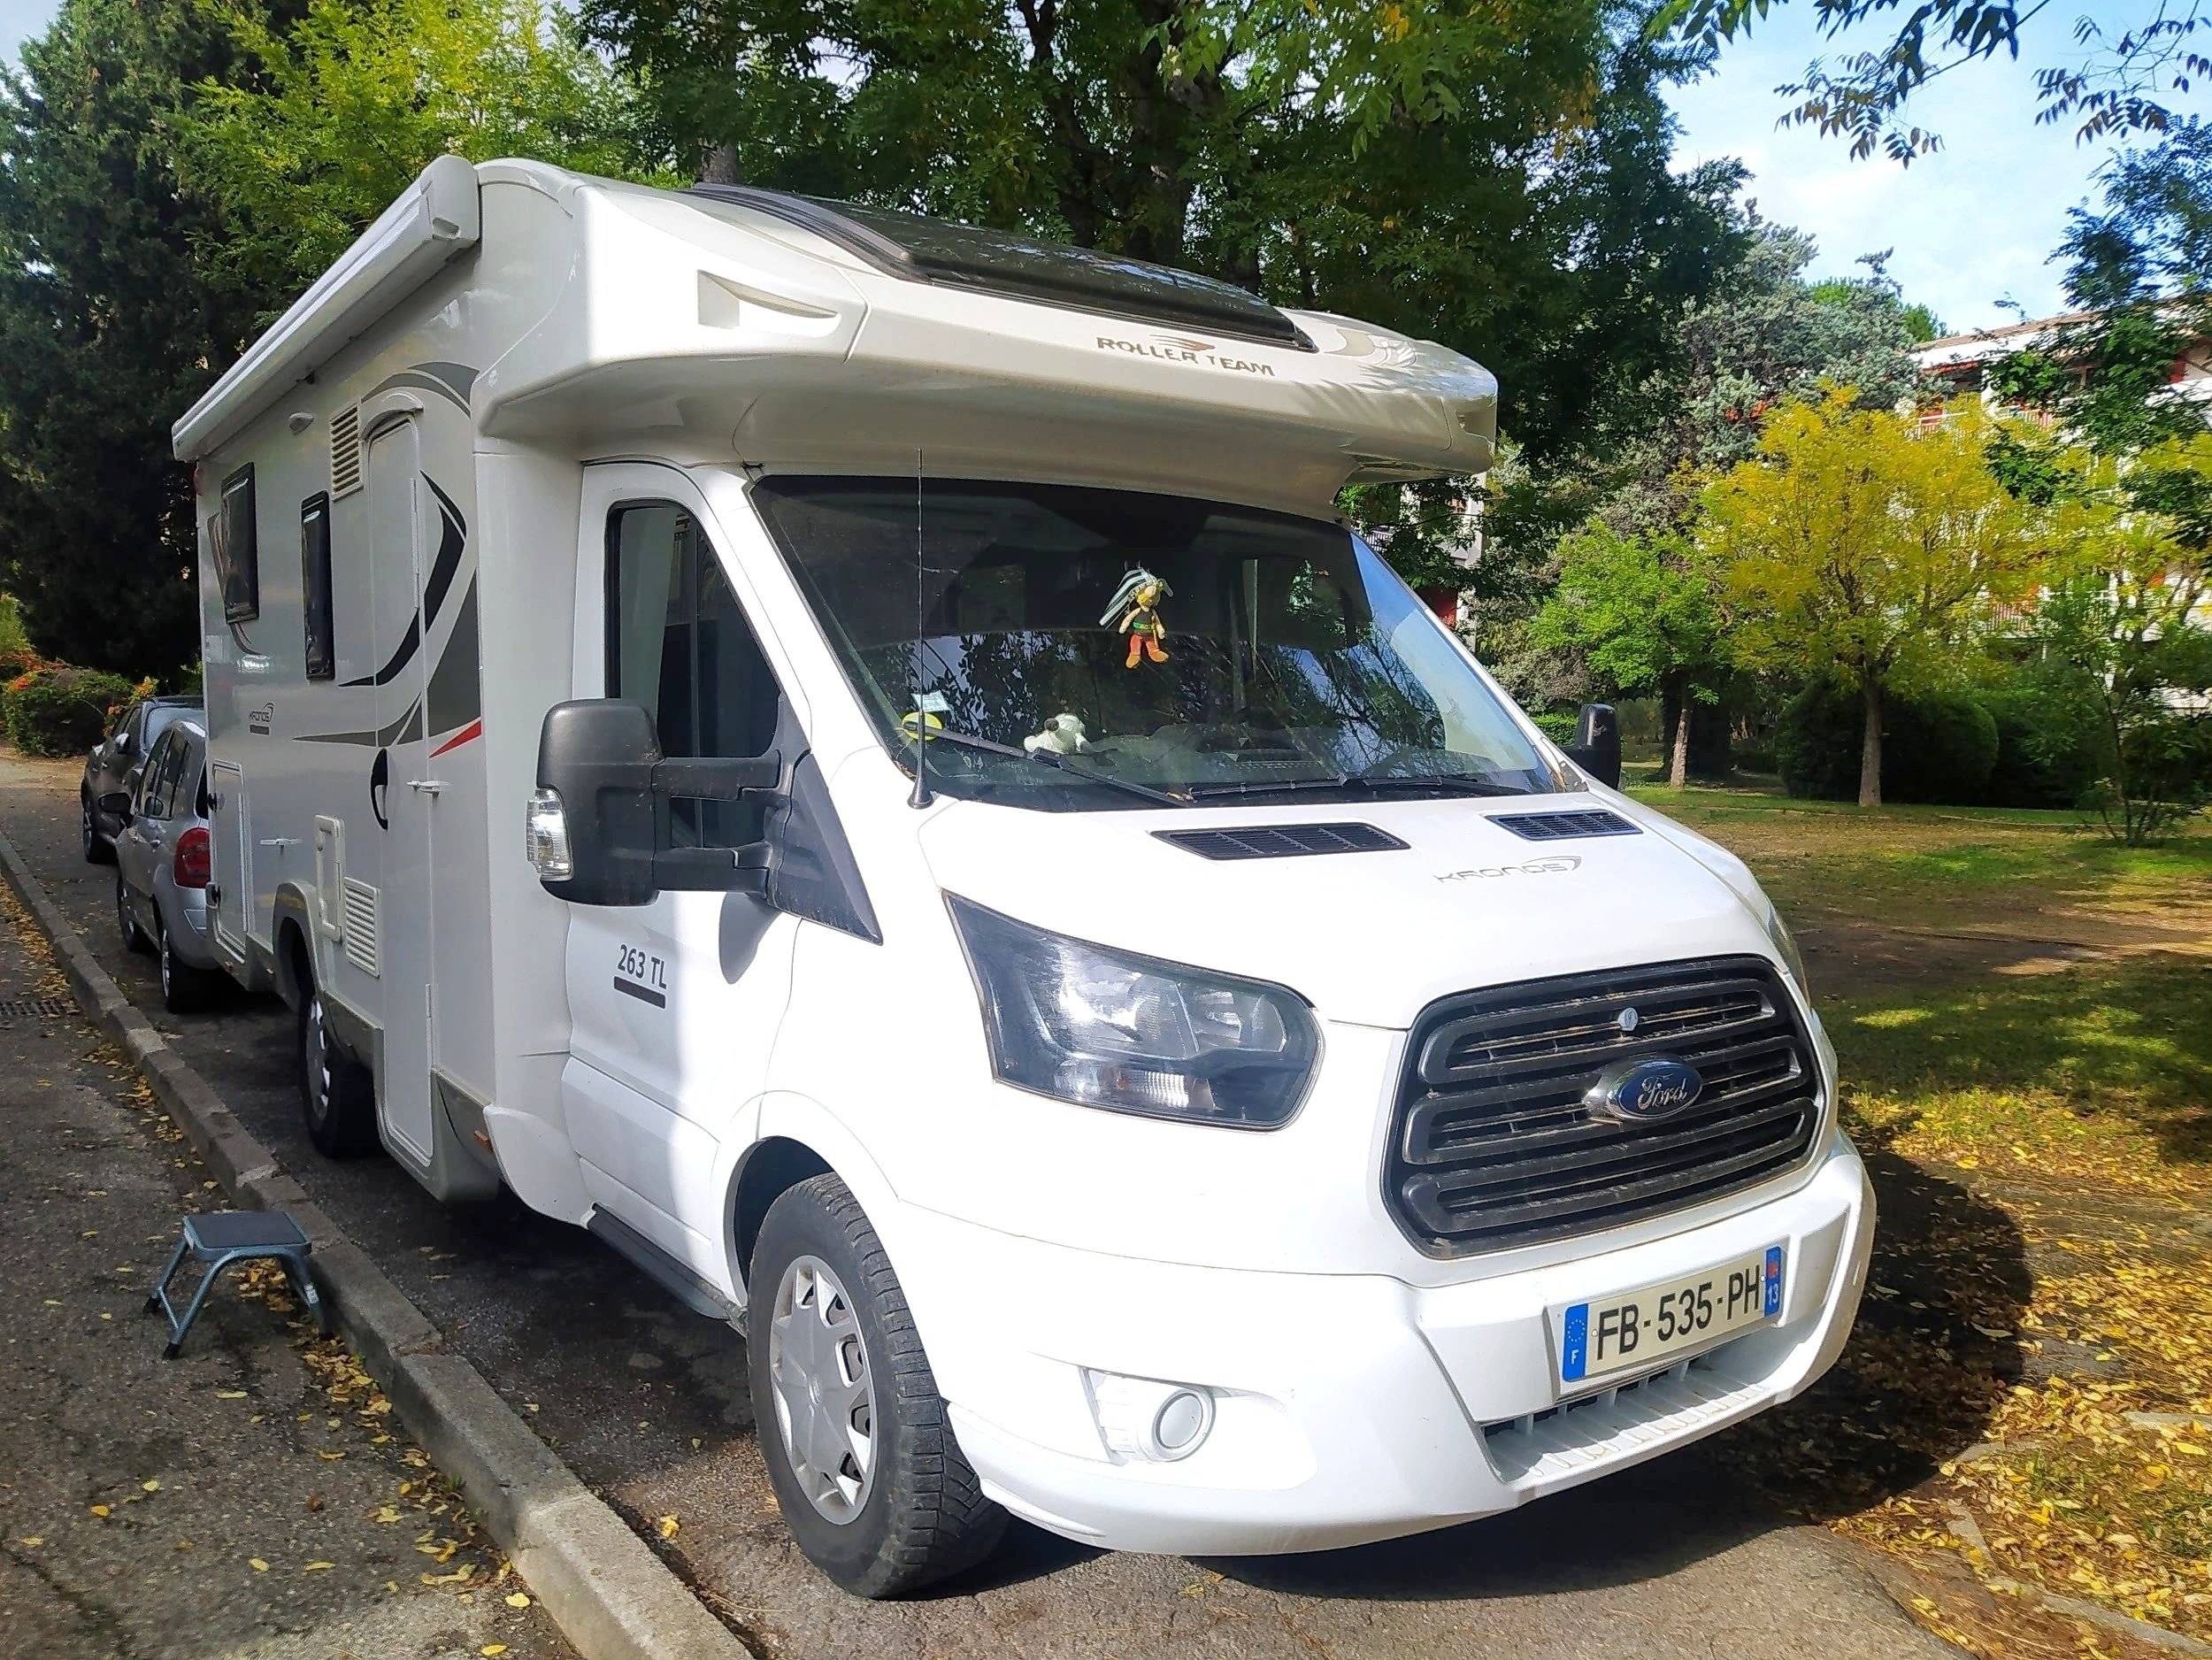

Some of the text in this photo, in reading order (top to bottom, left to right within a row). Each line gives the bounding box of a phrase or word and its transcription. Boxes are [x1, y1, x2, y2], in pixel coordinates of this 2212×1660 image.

[1095, 336, 1276, 377] ROLLER TEAM
[617, 943, 667, 990] 263 TL
[1637, 1072, 1688, 1111] Ford
[1596, 1264, 1761, 1361] FB-535-PH
[1767, 1282, 1779, 1306] 13
[1570, 1349, 1579, 1365] F
